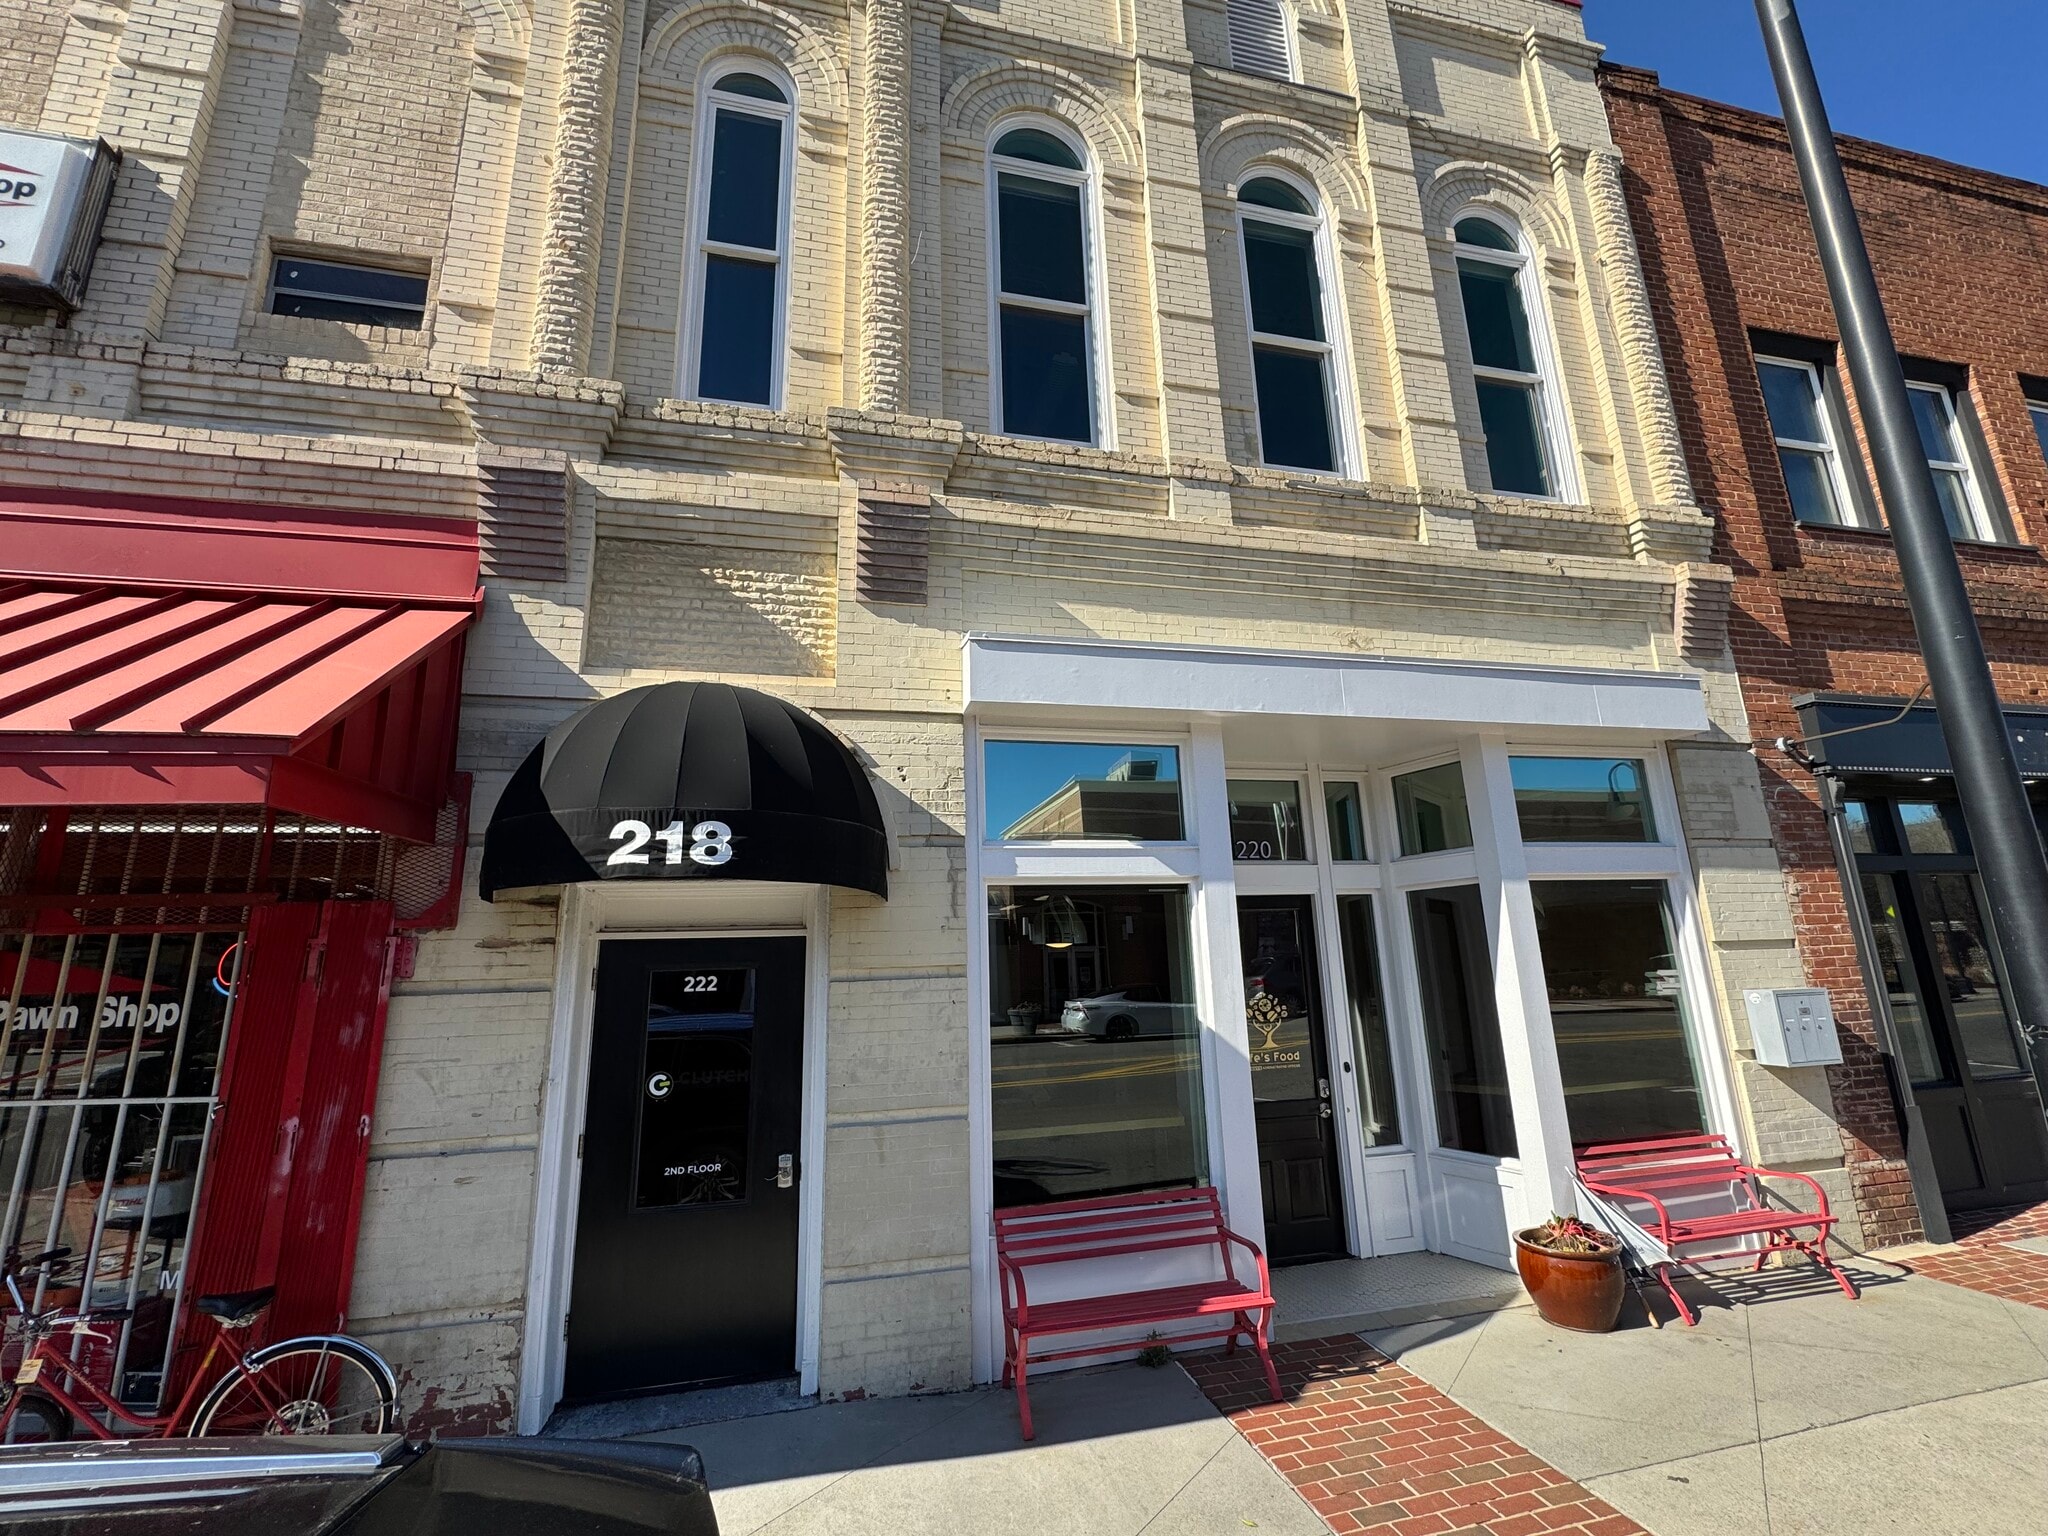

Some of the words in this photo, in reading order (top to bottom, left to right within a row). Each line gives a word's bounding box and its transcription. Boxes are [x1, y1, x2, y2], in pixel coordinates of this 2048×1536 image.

[606, 819, 733, 866] 218
[1235, 840, 1272, 859] 220
[683, 975, 718, 993] 222
[0, 1000, 79, 1032] Pawn
[99, 996, 180, 1034] Shop
[1273, 1051, 1300, 1062] Food
[663, 1165, 685, 1176] 2ND
[687, 1163, 722, 1175] FLOOR
